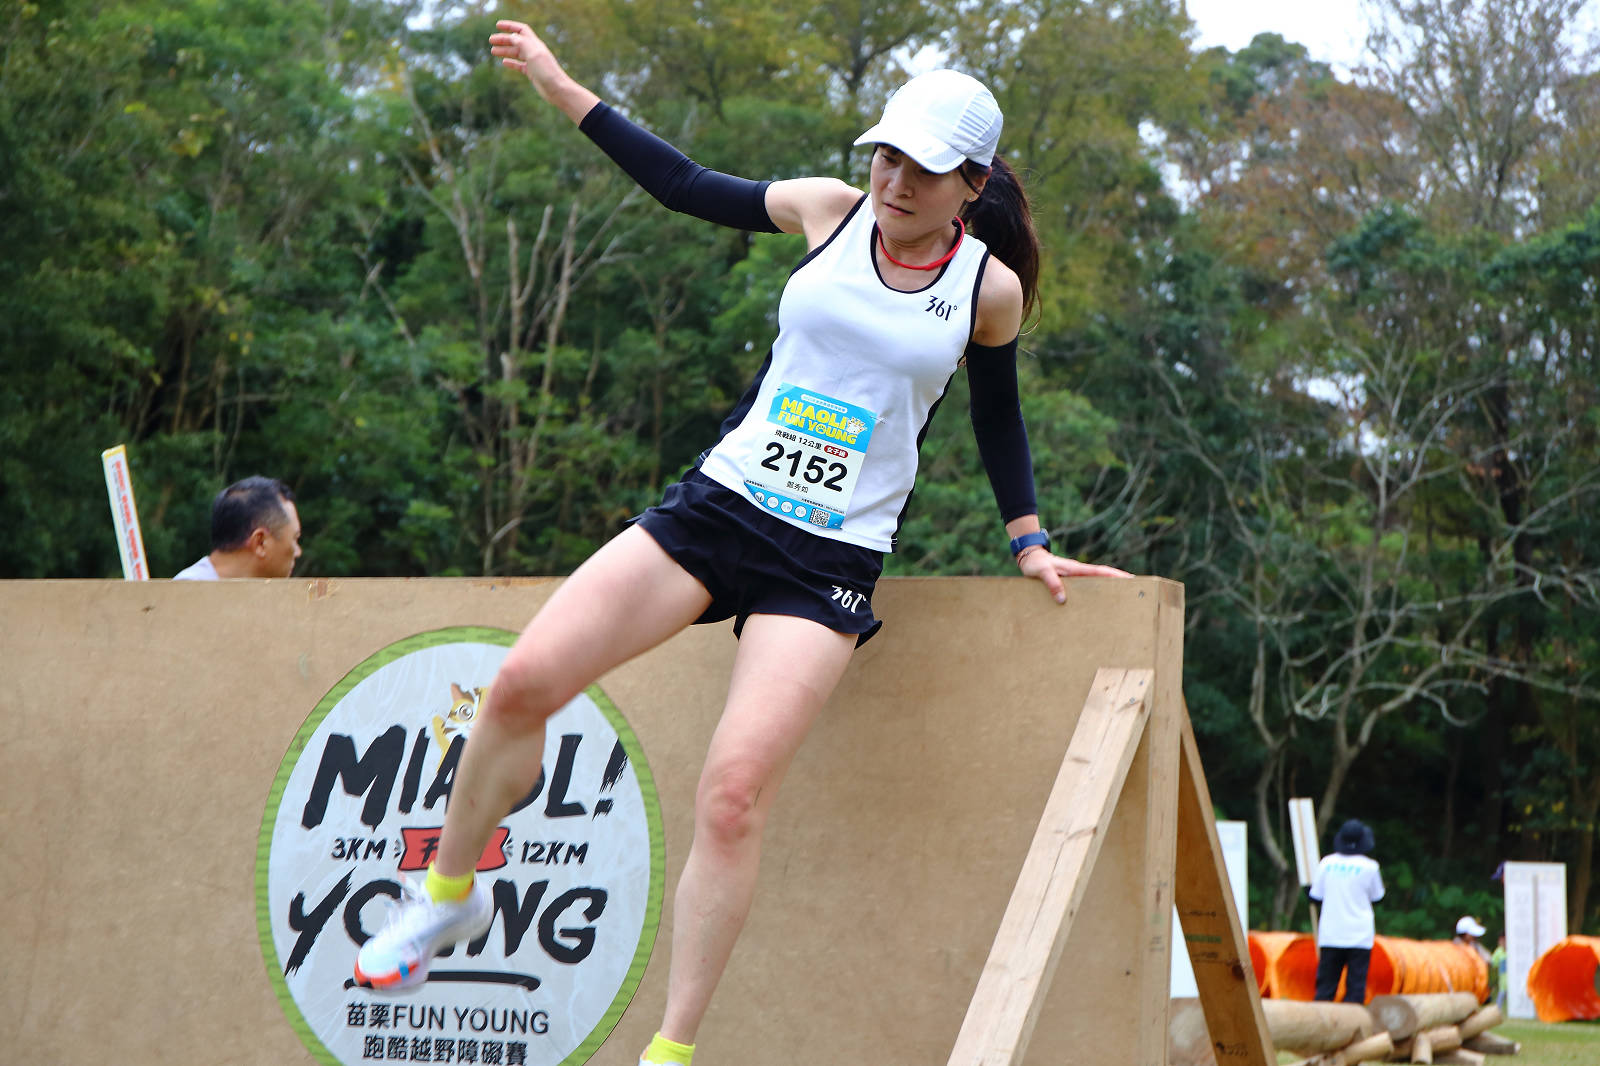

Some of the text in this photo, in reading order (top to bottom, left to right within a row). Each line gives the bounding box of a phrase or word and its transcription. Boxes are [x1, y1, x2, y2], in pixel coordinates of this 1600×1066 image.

[777, 410, 858, 444] FUN YOUNG
[781, 397, 848, 430] MIAOLI
[760, 441, 848, 493] 2152
[331, 838, 387, 861] 3KM
[520, 840, 589, 865] 12KM
[284, 866, 608, 977] YONG
[453, 1006, 550, 1034] YOUNG
[363, 1034, 528, 1066] 跑酷越野障礙賽
